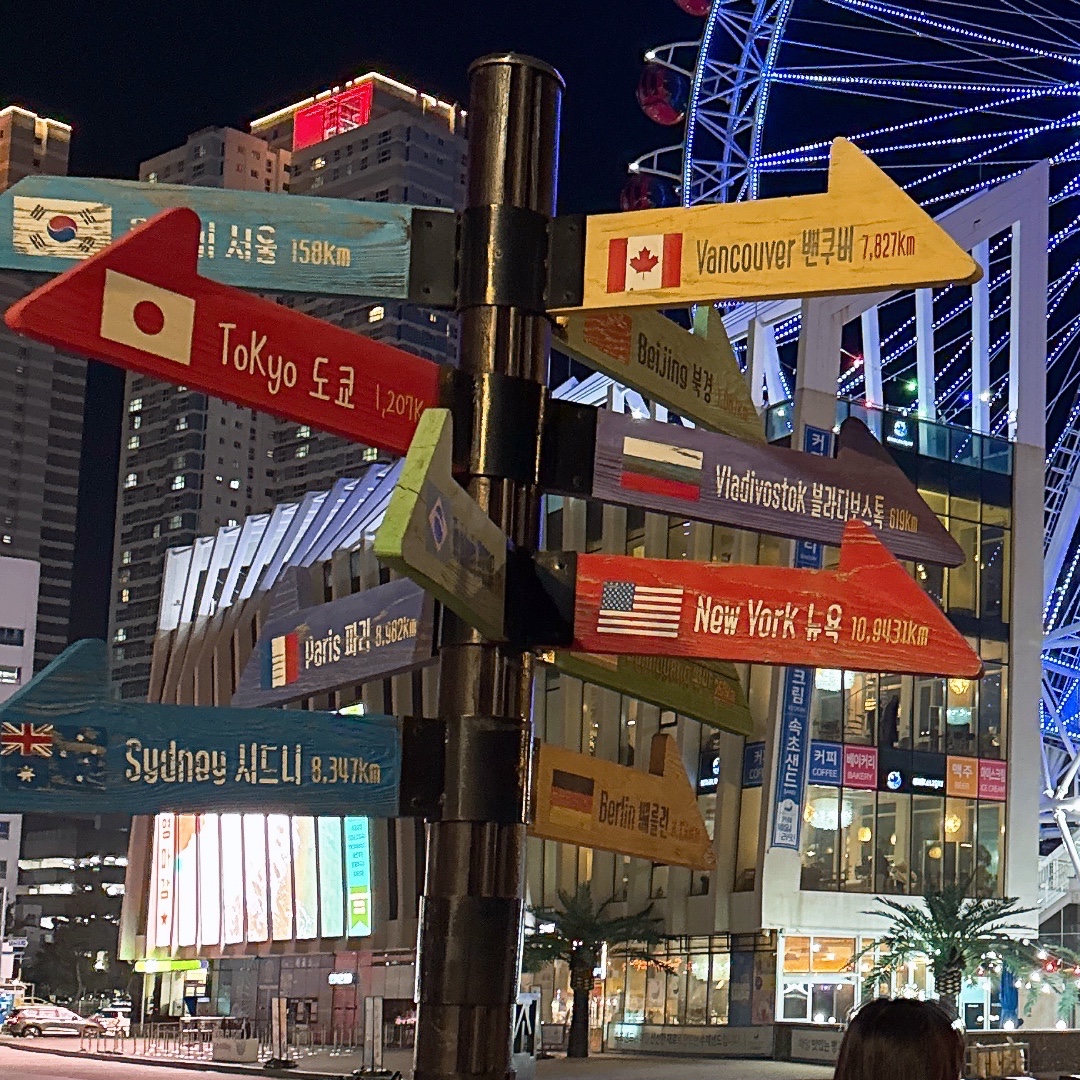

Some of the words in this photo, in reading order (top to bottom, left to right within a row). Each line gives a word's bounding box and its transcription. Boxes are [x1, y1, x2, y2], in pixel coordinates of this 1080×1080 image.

[225, 223, 279, 266] 서울
[696, 238, 797, 276] Vancouver
[802, 225, 854, 268] 밴쿠버
[309, 356, 355, 410] 도쿄
[637, 332, 689, 390] Beijing
[693, 363, 714, 404] 북경
[716, 463, 808, 515] Vladivostok
[344, 617, 372, 657] 파리
[693, 595, 741, 635] New
[748, 598, 799, 639] York
[804, 603, 843, 644] 뉴욕
[125, 737, 227, 786] Sydney
[234, 742, 301, 785] 시드니
[784, 717, 803, 788] 속초샌드
[812, 767, 838, 778] COFFEE
[813, 749, 837, 765] 커피
[846, 752, 876, 770] 베이커리
[951, 763, 974, 779] 맥주
[847, 770, 874, 781] BAKERY
[598, 789, 636, 831] Berlin
